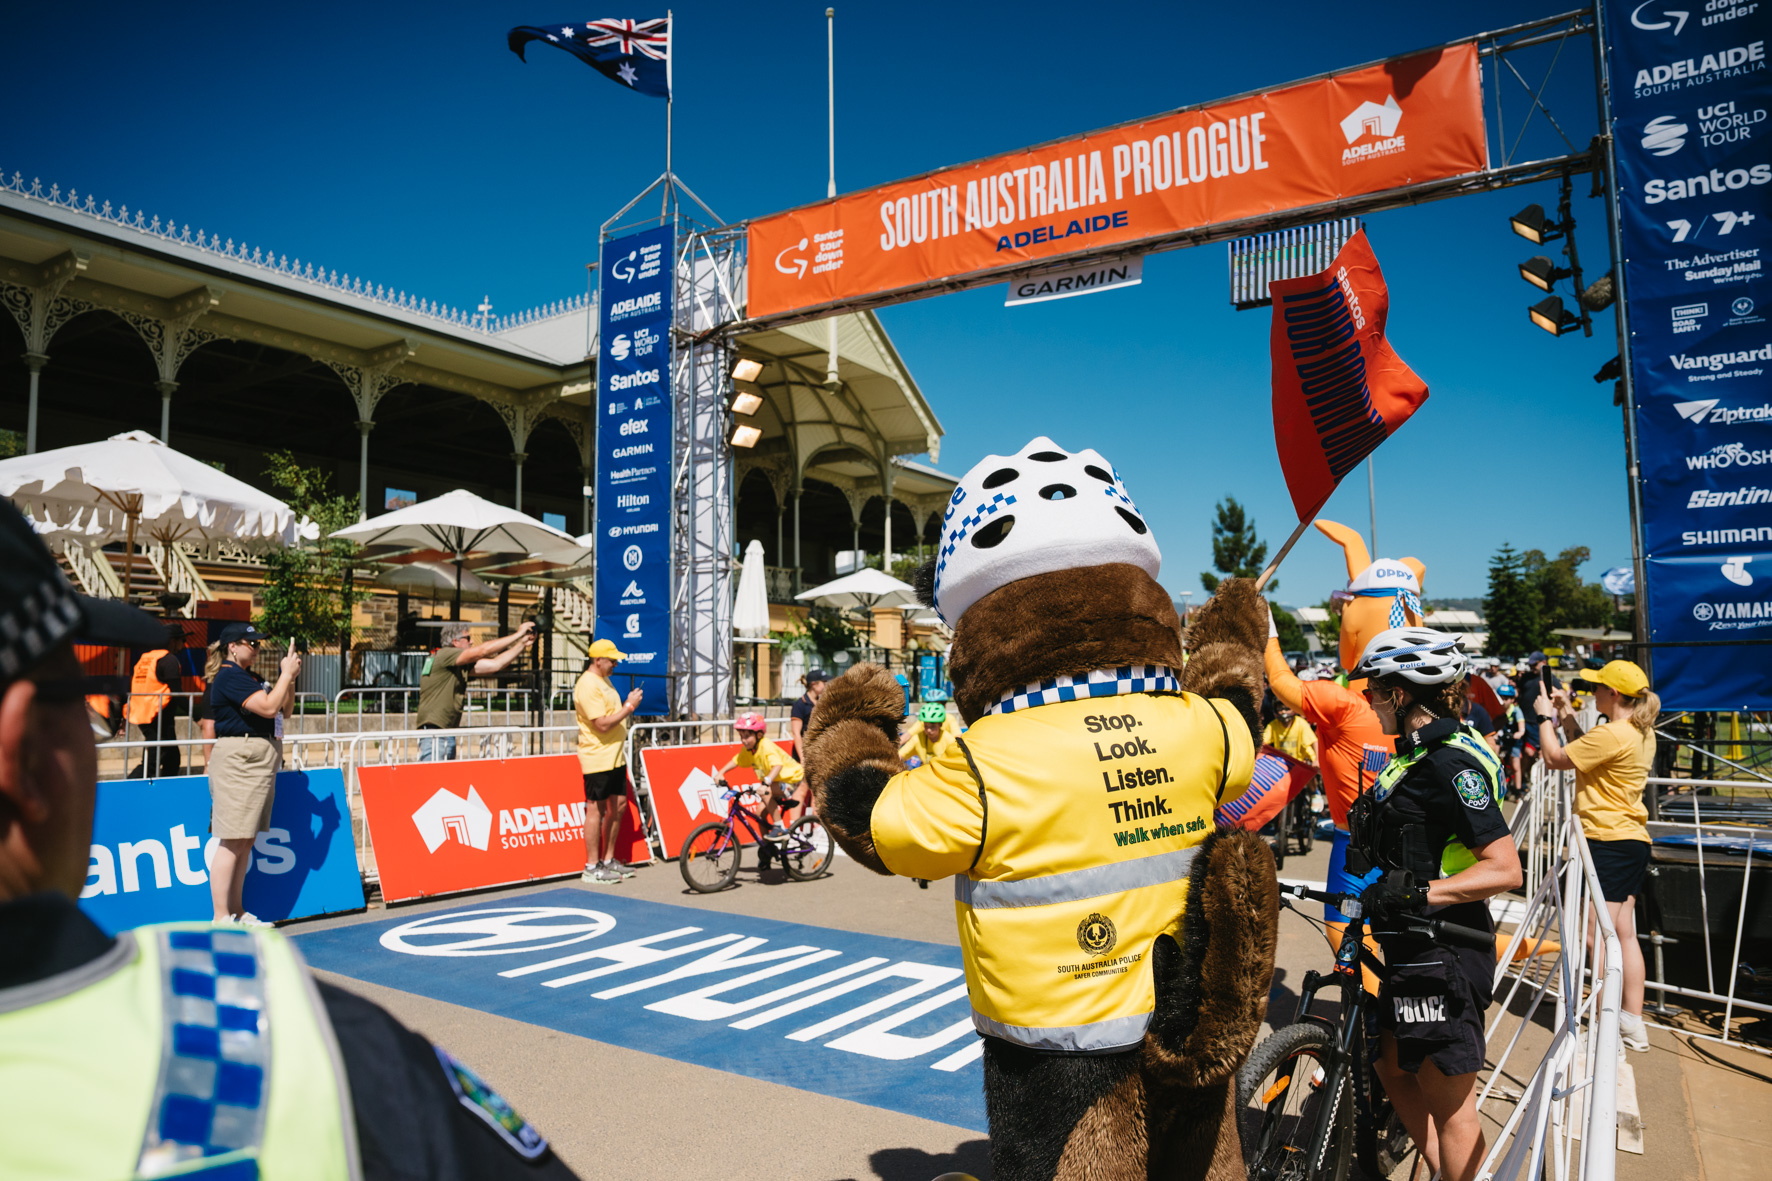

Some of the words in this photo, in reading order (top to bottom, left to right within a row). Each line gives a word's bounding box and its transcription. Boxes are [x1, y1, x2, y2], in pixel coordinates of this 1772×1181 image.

[1701, 3, 1758, 26] under
[1634, 40, 1765, 89] ADELAIDE
[1634, 82, 1680, 99] SOUTH
[1686, 60, 1766, 87] AUSTRALIA
[1697, 101, 1735, 120] UCI
[1699, 109, 1767, 134] WORLD
[1341, 135, 1406, 161] ADELAIDE
[1700, 126, 1751, 148] TOUR
[1342, 156, 1366, 167] SOUTH
[1367, 146, 1406, 160] AUSTRALIA
[880, 184, 959, 252] SOUTH
[964, 149, 1107, 233] AUSTRALIA
[1112, 111, 1269, 201] PROLOGUE
[1644, 163, 1772, 205] Santos
[813, 229, 844, 243] Santos
[995, 210, 1129, 252] ADELAIDE
[815, 249, 843, 263] down
[820, 239, 844, 252] tour
[813, 260, 844, 274] under
[1665, 258, 1690, 271] The
[1690, 248, 1760, 268] Advertiser
[1685, 265, 1733, 281] Sunday
[1733, 260, 1762, 274] Mail
[1017, 265, 1128, 297] GARMIN
[610, 291, 661, 317] ADELAIDE
[1336, 265, 1366, 331] Santos
[1282, 275, 1356, 360] TOUR
[1672, 319, 1696, 328] ROAD
[634, 328, 649, 339] UCI
[1673, 324, 1702, 334] SAFETY
[634, 334, 660, 348] WORLD
[635, 344, 653, 357] TOUR
[1669, 344, 1772, 371] Vanguard
[609, 368, 660, 391] Santos
[1295, 338, 1377, 435] DOWN
[1687, 374, 1716, 383] Strong
[1716, 371, 1733, 380] and
[1733, 368, 1764, 378] Steady
[612, 443, 654, 458] GARMIN
[617, 494, 650, 508] Hilton
[623, 523, 659, 535] HYUNDAI
[1400, 661, 1426, 670] Police
[1083, 713, 1143, 733] Stop.
[1093, 736, 1157, 762] Look.
[1363, 743, 1388, 752] Santos
[1102, 767, 1175, 793] Listen.
[1108, 795, 1173, 824] Think.
[1468, 793, 1490, 807] POLICE
[500, 832, 545, 849] SOUTH
[1113, 827, 1150, 847] Walk
[1150, 822, 1185, 840] when
[1185, 816, 1207, 832] safe.
[78, 823, 297, 899] ants
[1057, 964, 1080, 974] SOUTH
[1081, 958, 1118, 972] AUSTRALIA
[1119, 953, 1142, 965] POLICE
[1074, 972, 1091, 980] SAFER
[1091, 966, 1128, 978] COMMUNITIES
[496, 924, 986, 1072] HYUND
[1393, 995, 1447, 1023] POLICE
